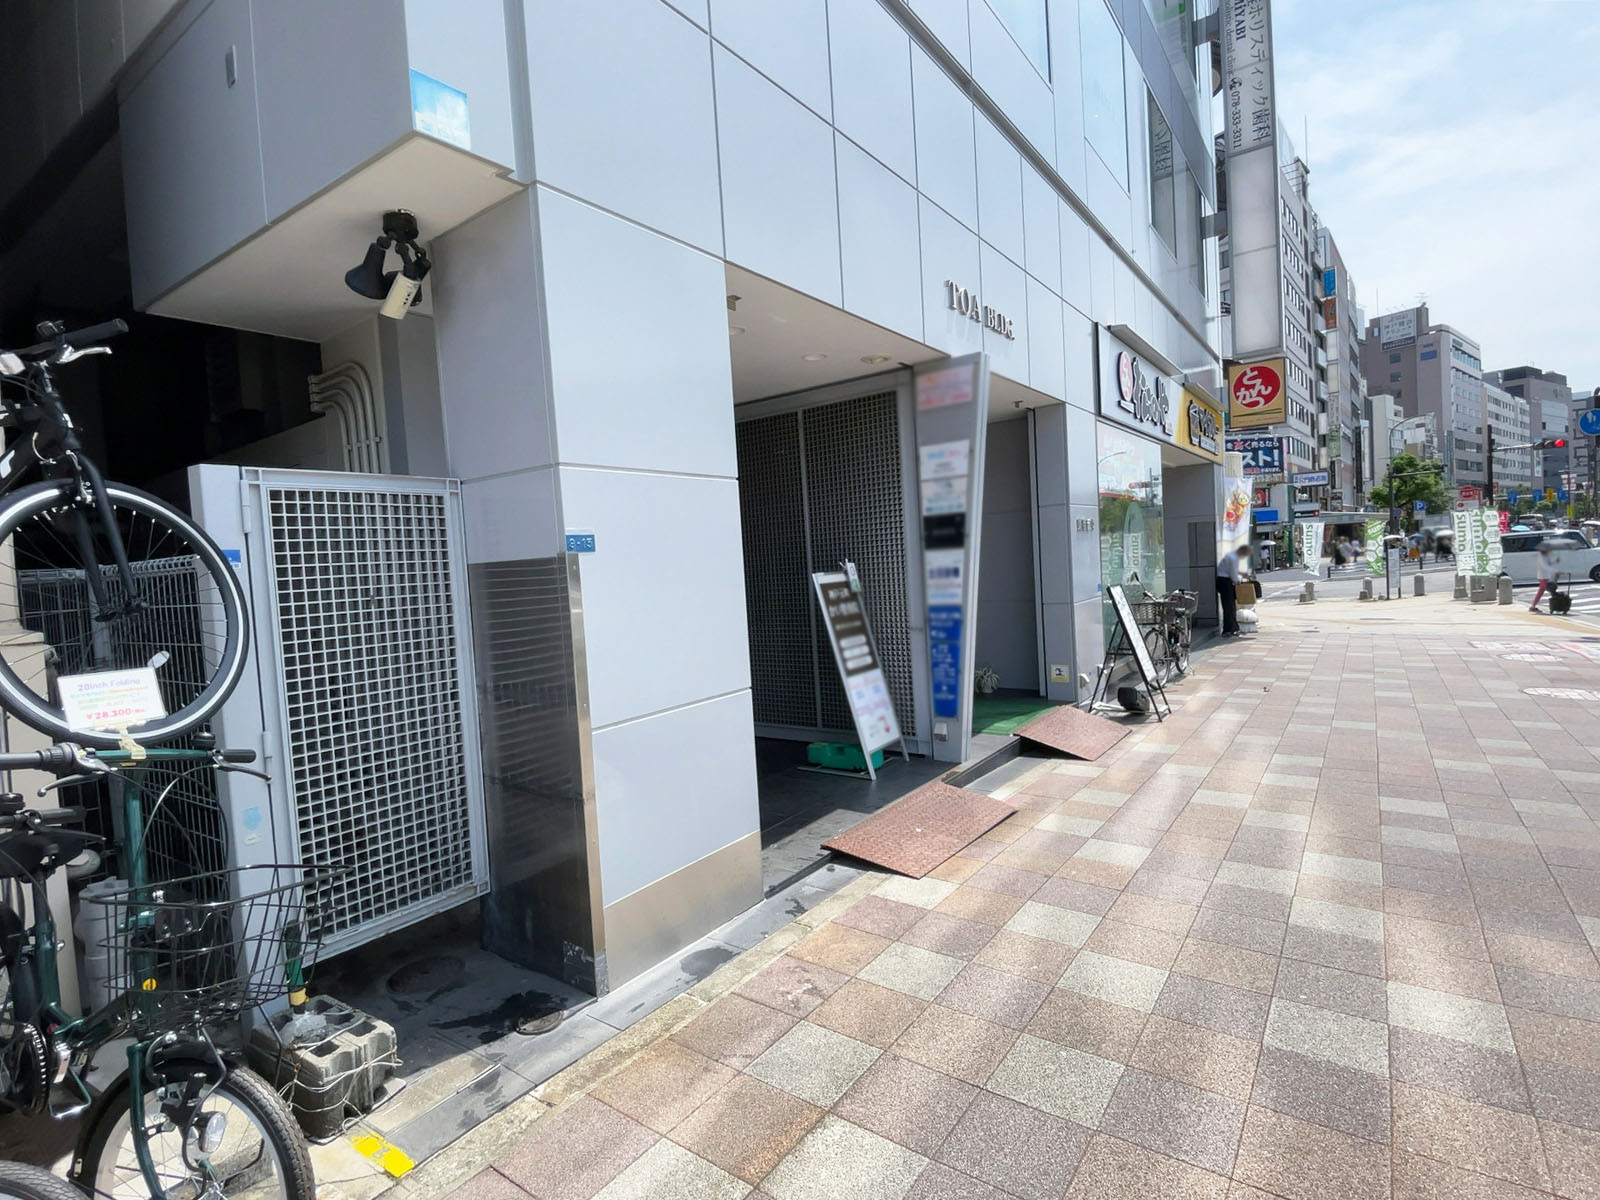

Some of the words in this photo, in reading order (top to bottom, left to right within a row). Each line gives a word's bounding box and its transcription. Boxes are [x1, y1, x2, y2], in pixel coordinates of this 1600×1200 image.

[1231, 90, 1242, 149] 078-333-3311
[944, 280, 981, 323] TOA
[1236, 367, 1272, 408] とんかつ
